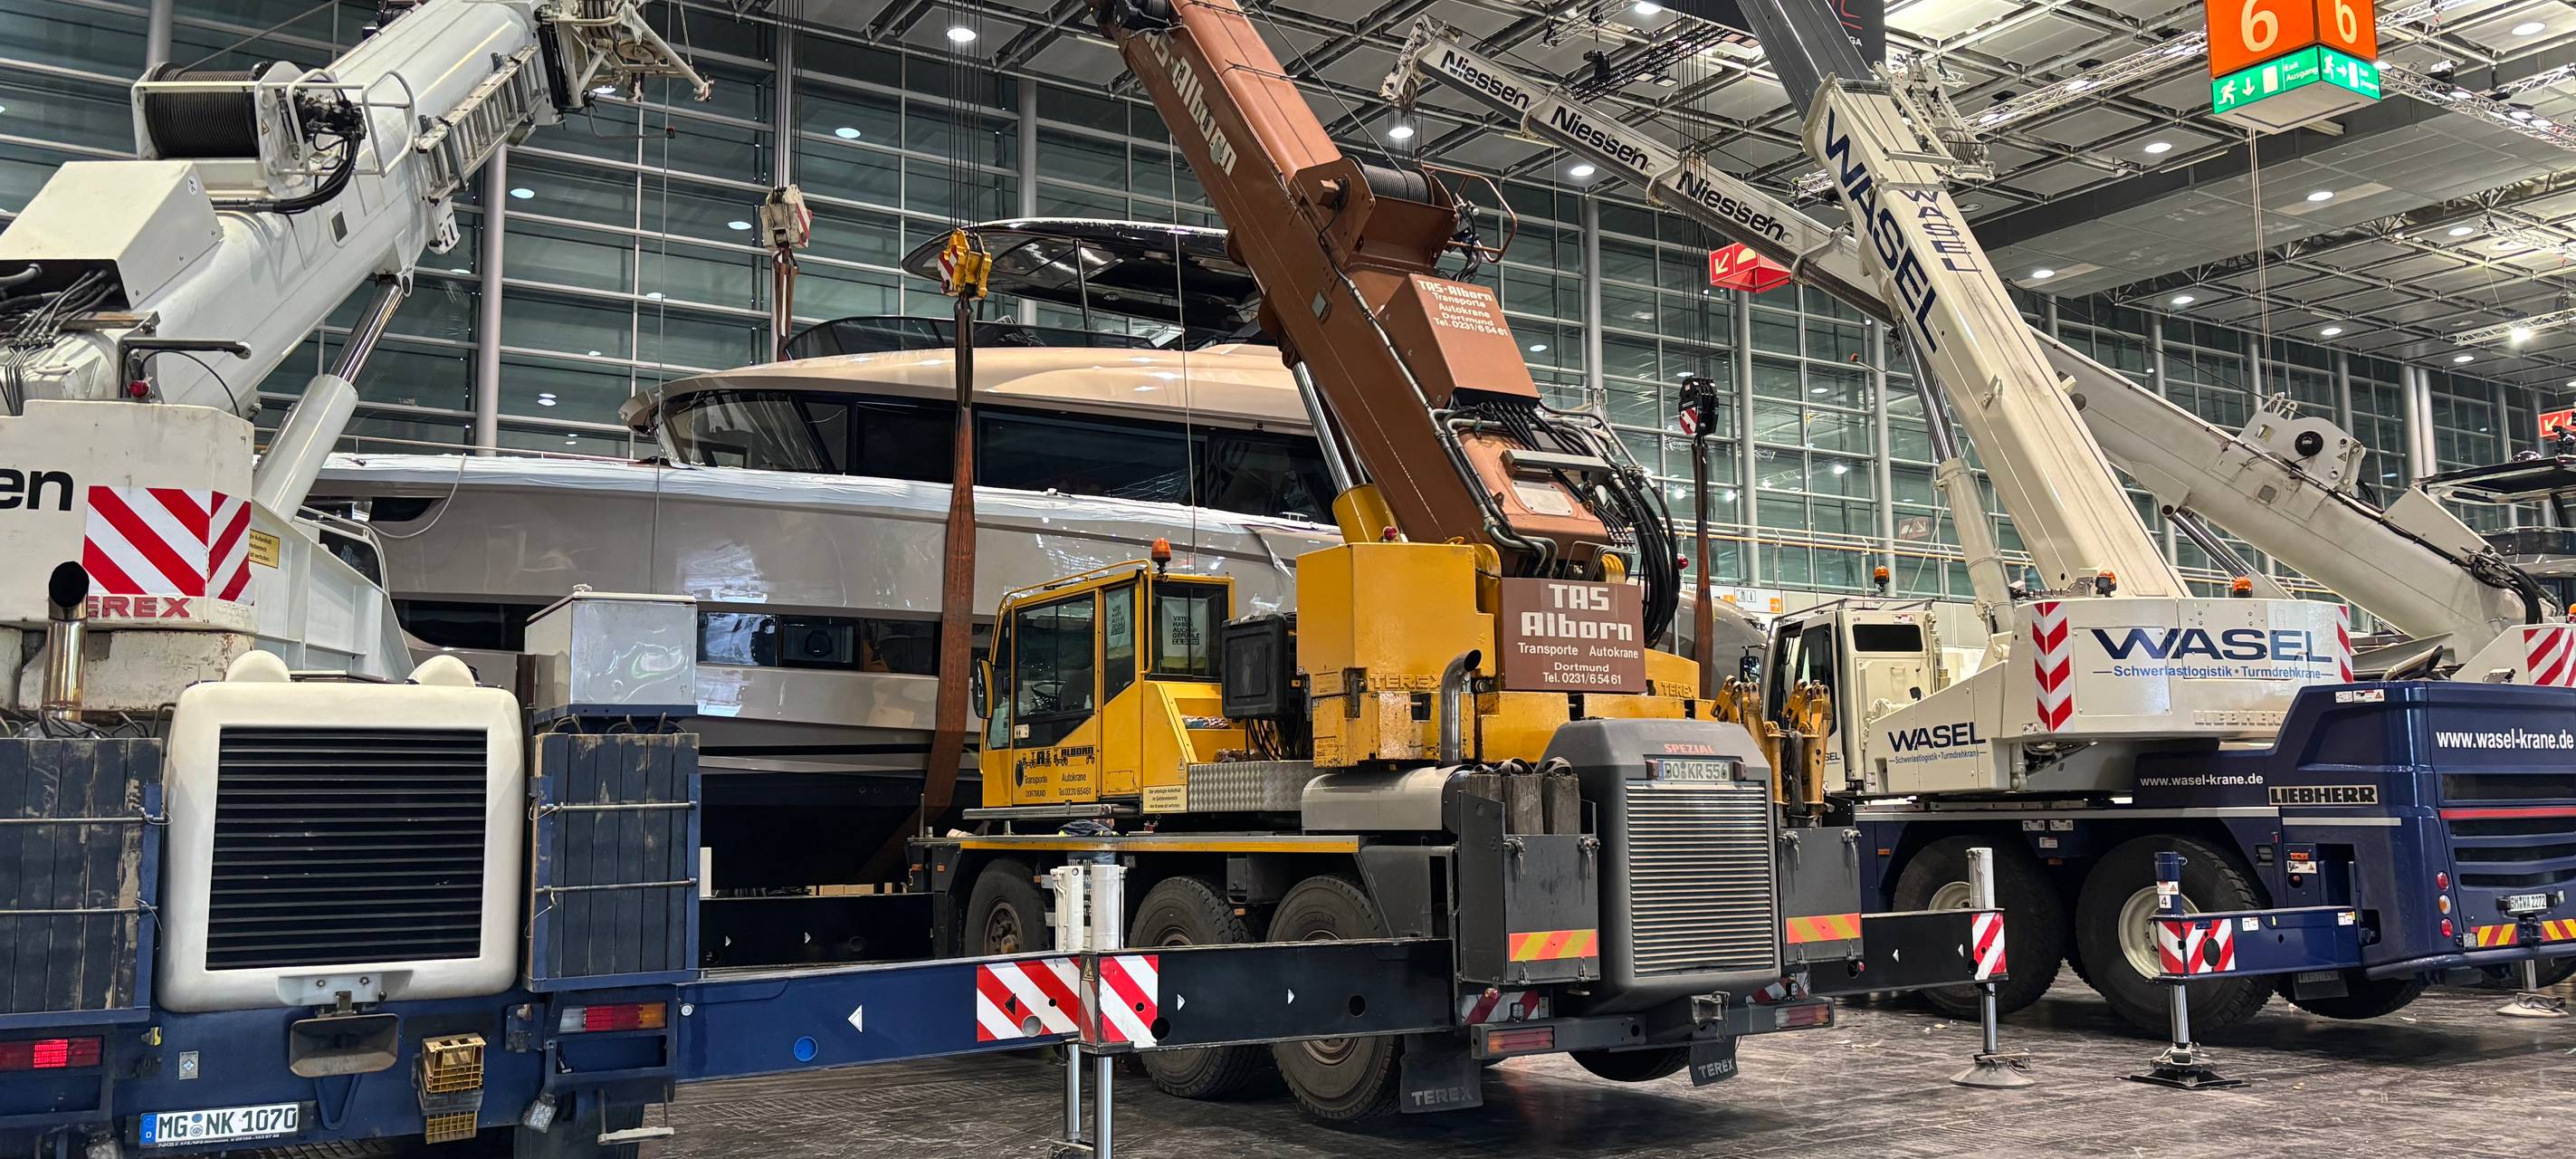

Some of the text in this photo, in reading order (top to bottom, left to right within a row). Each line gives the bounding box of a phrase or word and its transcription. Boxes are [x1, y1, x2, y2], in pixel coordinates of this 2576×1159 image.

[2241, 0, 2279, 53] 6
[2334, 0, 2358, 44] 6
[1440, 49, 1530, 110] Niessen
[2285, 66, 2319, 81] Ausgang
[1550, 105, 1648, 173] Niessen
[1675, 169, 1784, 241] Niessen
[1825, 106, 1938, 354] WASEL
[1898, 188, 1982, 273] WASEL
[1417, 280, 1493, 302] TAS-Alborn
[1431, 292, 1486, 309] Transporte
[1438, 302, 1491, 319] Autokrane
[1441, 311, 1493, 327] Dortmund
[1549, 583, 1609, 611] TAS
[1521, 611, 1633, 642] Alborn
[1517, 642, 1639, 658] Transporte Autokrane
[2091, 627, 2333, 663] WASEL
[1554, 662, 1609, 673] Dortmund
[2113, 666, 2321, 679] Schwerlastlogistik Turmdrehkrane
[1369, 674, 1443, 689] TEREX
[1542, 672, 1560, 683] Tel.
[1661, 681, 1695, 699] TEREX
[1887, 722, 1987, 752] WASEL
[2436, 728, 2574, 750] www.wasel-krane.de
[1664, 743, 1716, 754] SPEZIAL
[1894, 752, 1938, 764] Schwerlastlogistik
[1062, 772, 1087, 782] Autokrane
[1665, 762, 1727, 780] BO KR 556
[2140, 773, 2264, 787] www.wasel-krane.de
[2270, 787, 2376, 803] LIEBHERR
[2161, 896, 2167, 906] 4
[1697, 1058, 1734, 1079] TEREX
[1411, 1087, 1473, 1106] TEREX
[158, 1116, 188, 1139] MG
[205, 1111, 235, 1135] NK
[242, 1107, 297, 1132] 1070
